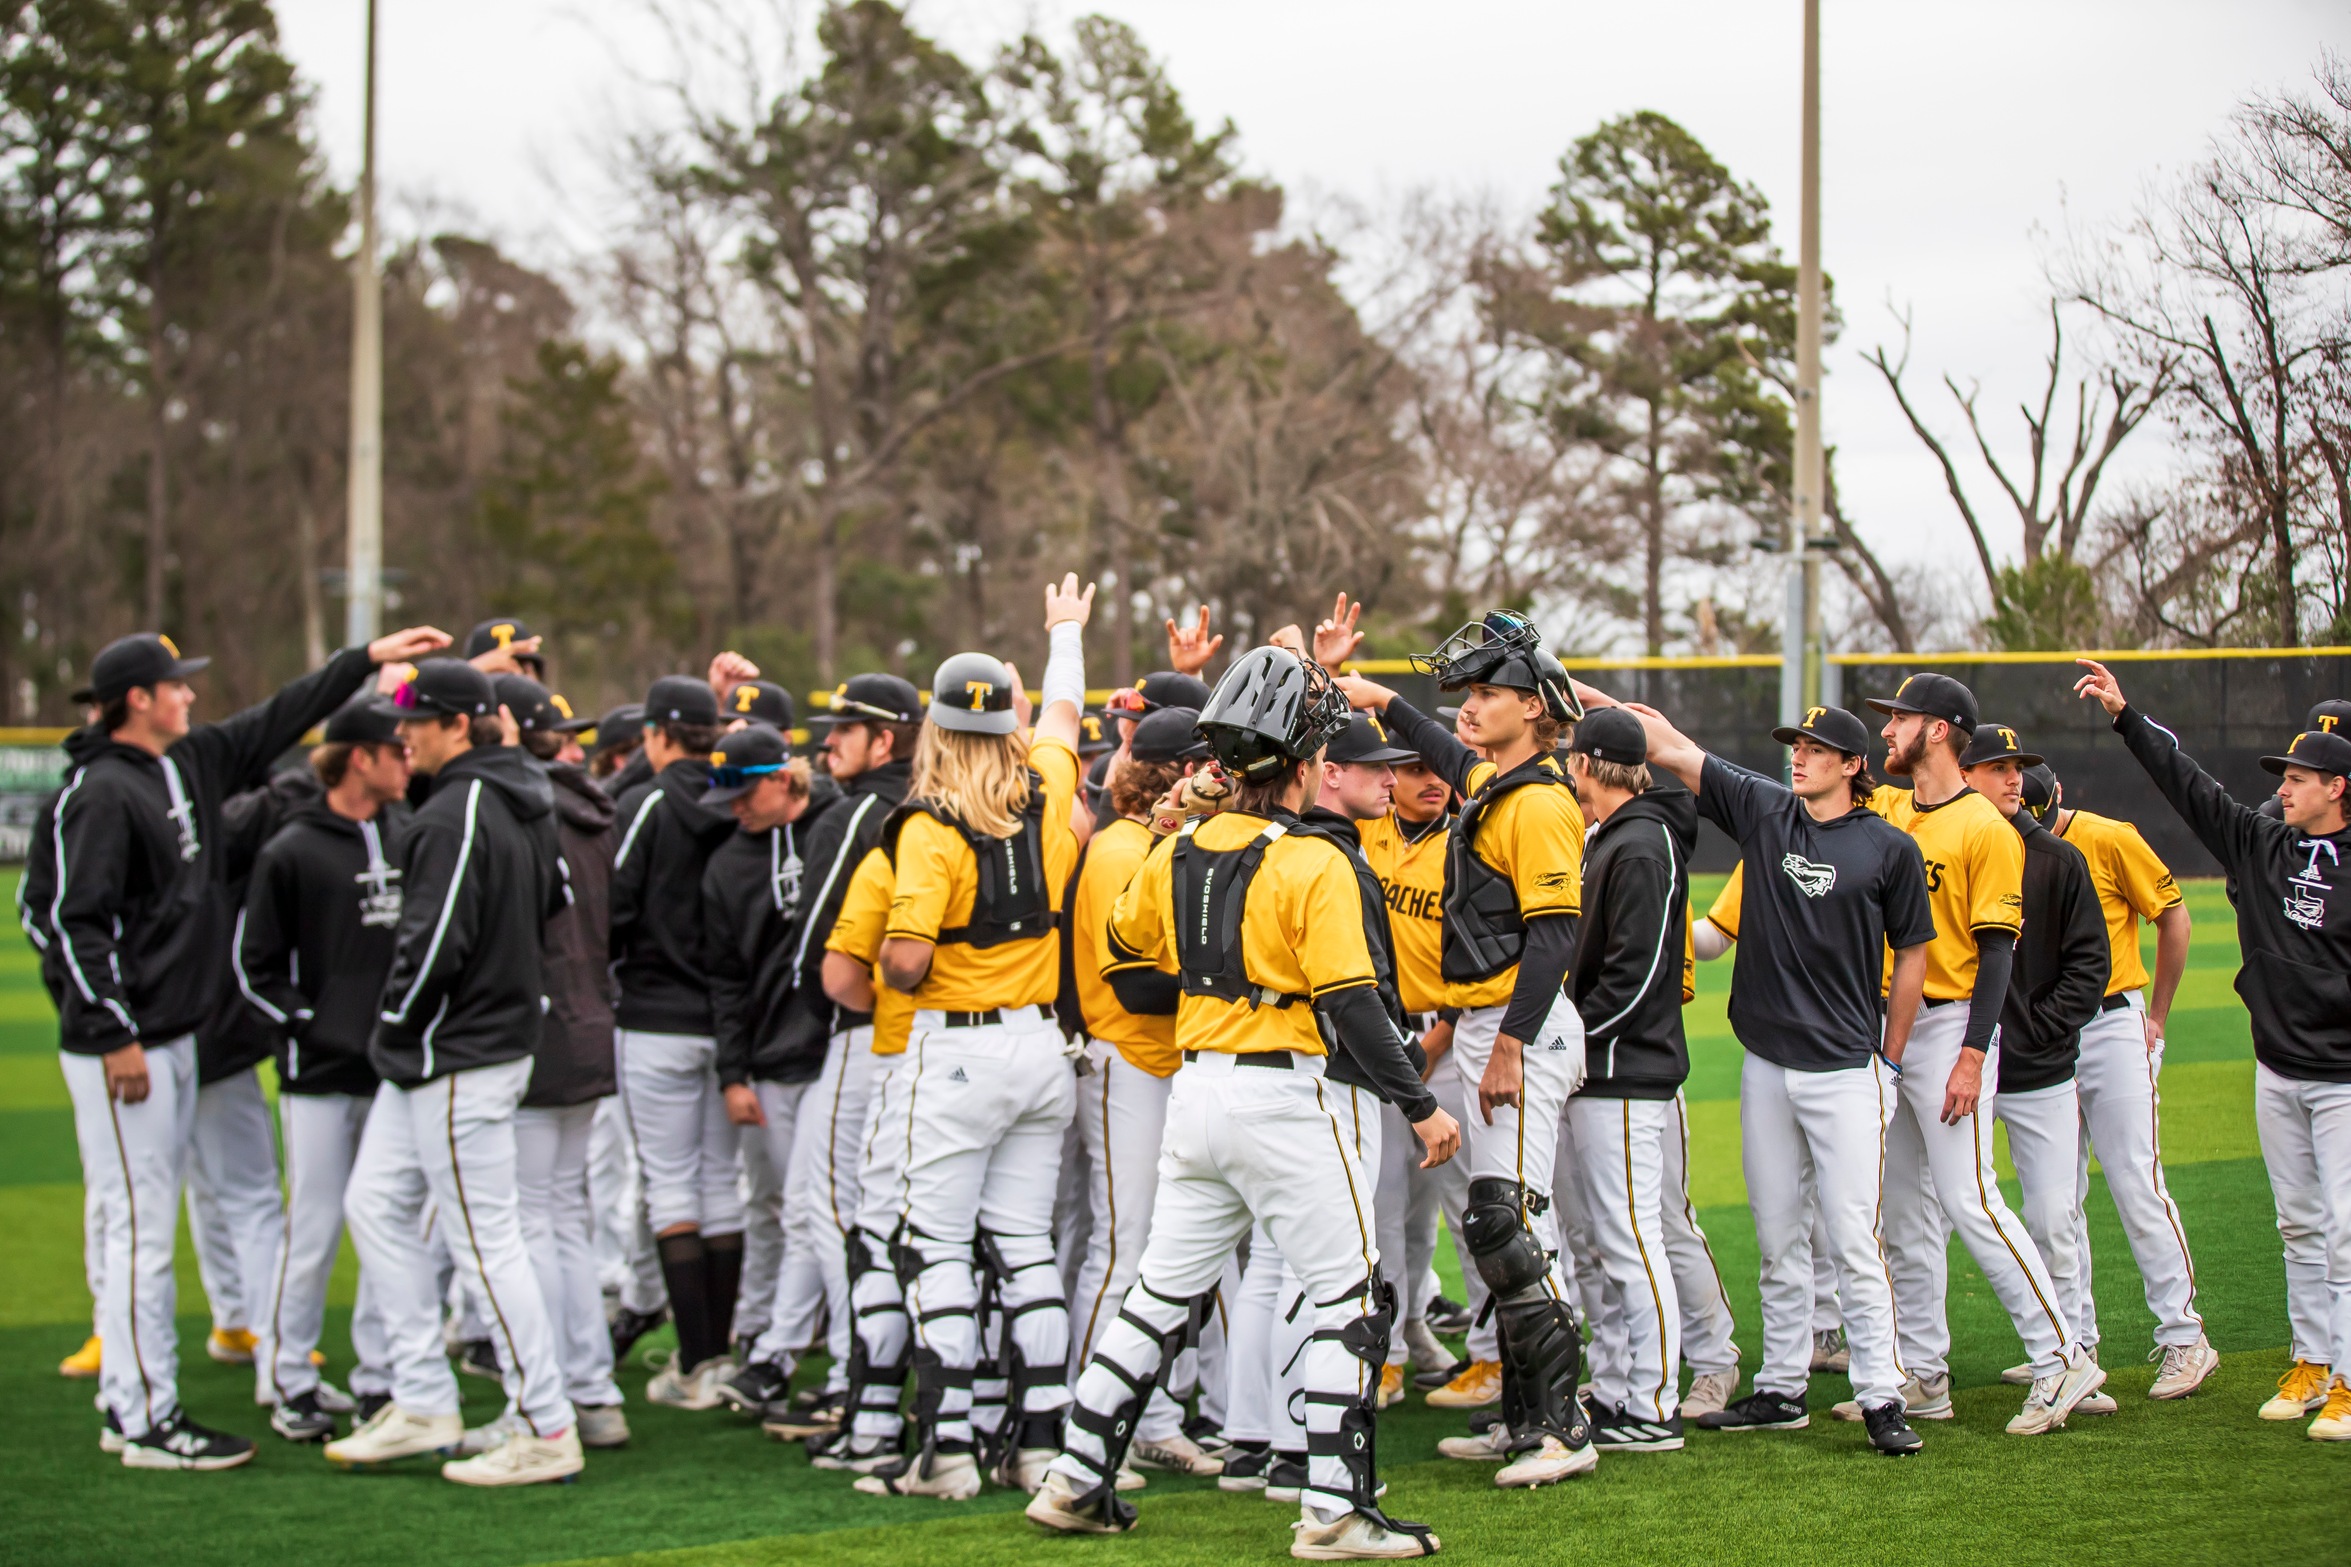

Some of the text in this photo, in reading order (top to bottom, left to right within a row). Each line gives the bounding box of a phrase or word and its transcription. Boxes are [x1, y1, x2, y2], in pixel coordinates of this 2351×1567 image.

[736, 686, 760, 712] T
[966, 681, 993, 711] T
[1802, 706, 1827, 728] T
[2318, 715, 2339, 734] T
[1081, 717, 1103, 741] T
[1997, 728, 2018, 750] T
[2287, 733, 2308, 755] T
[1201, 867, 1215, 945] EVOSHIELD
